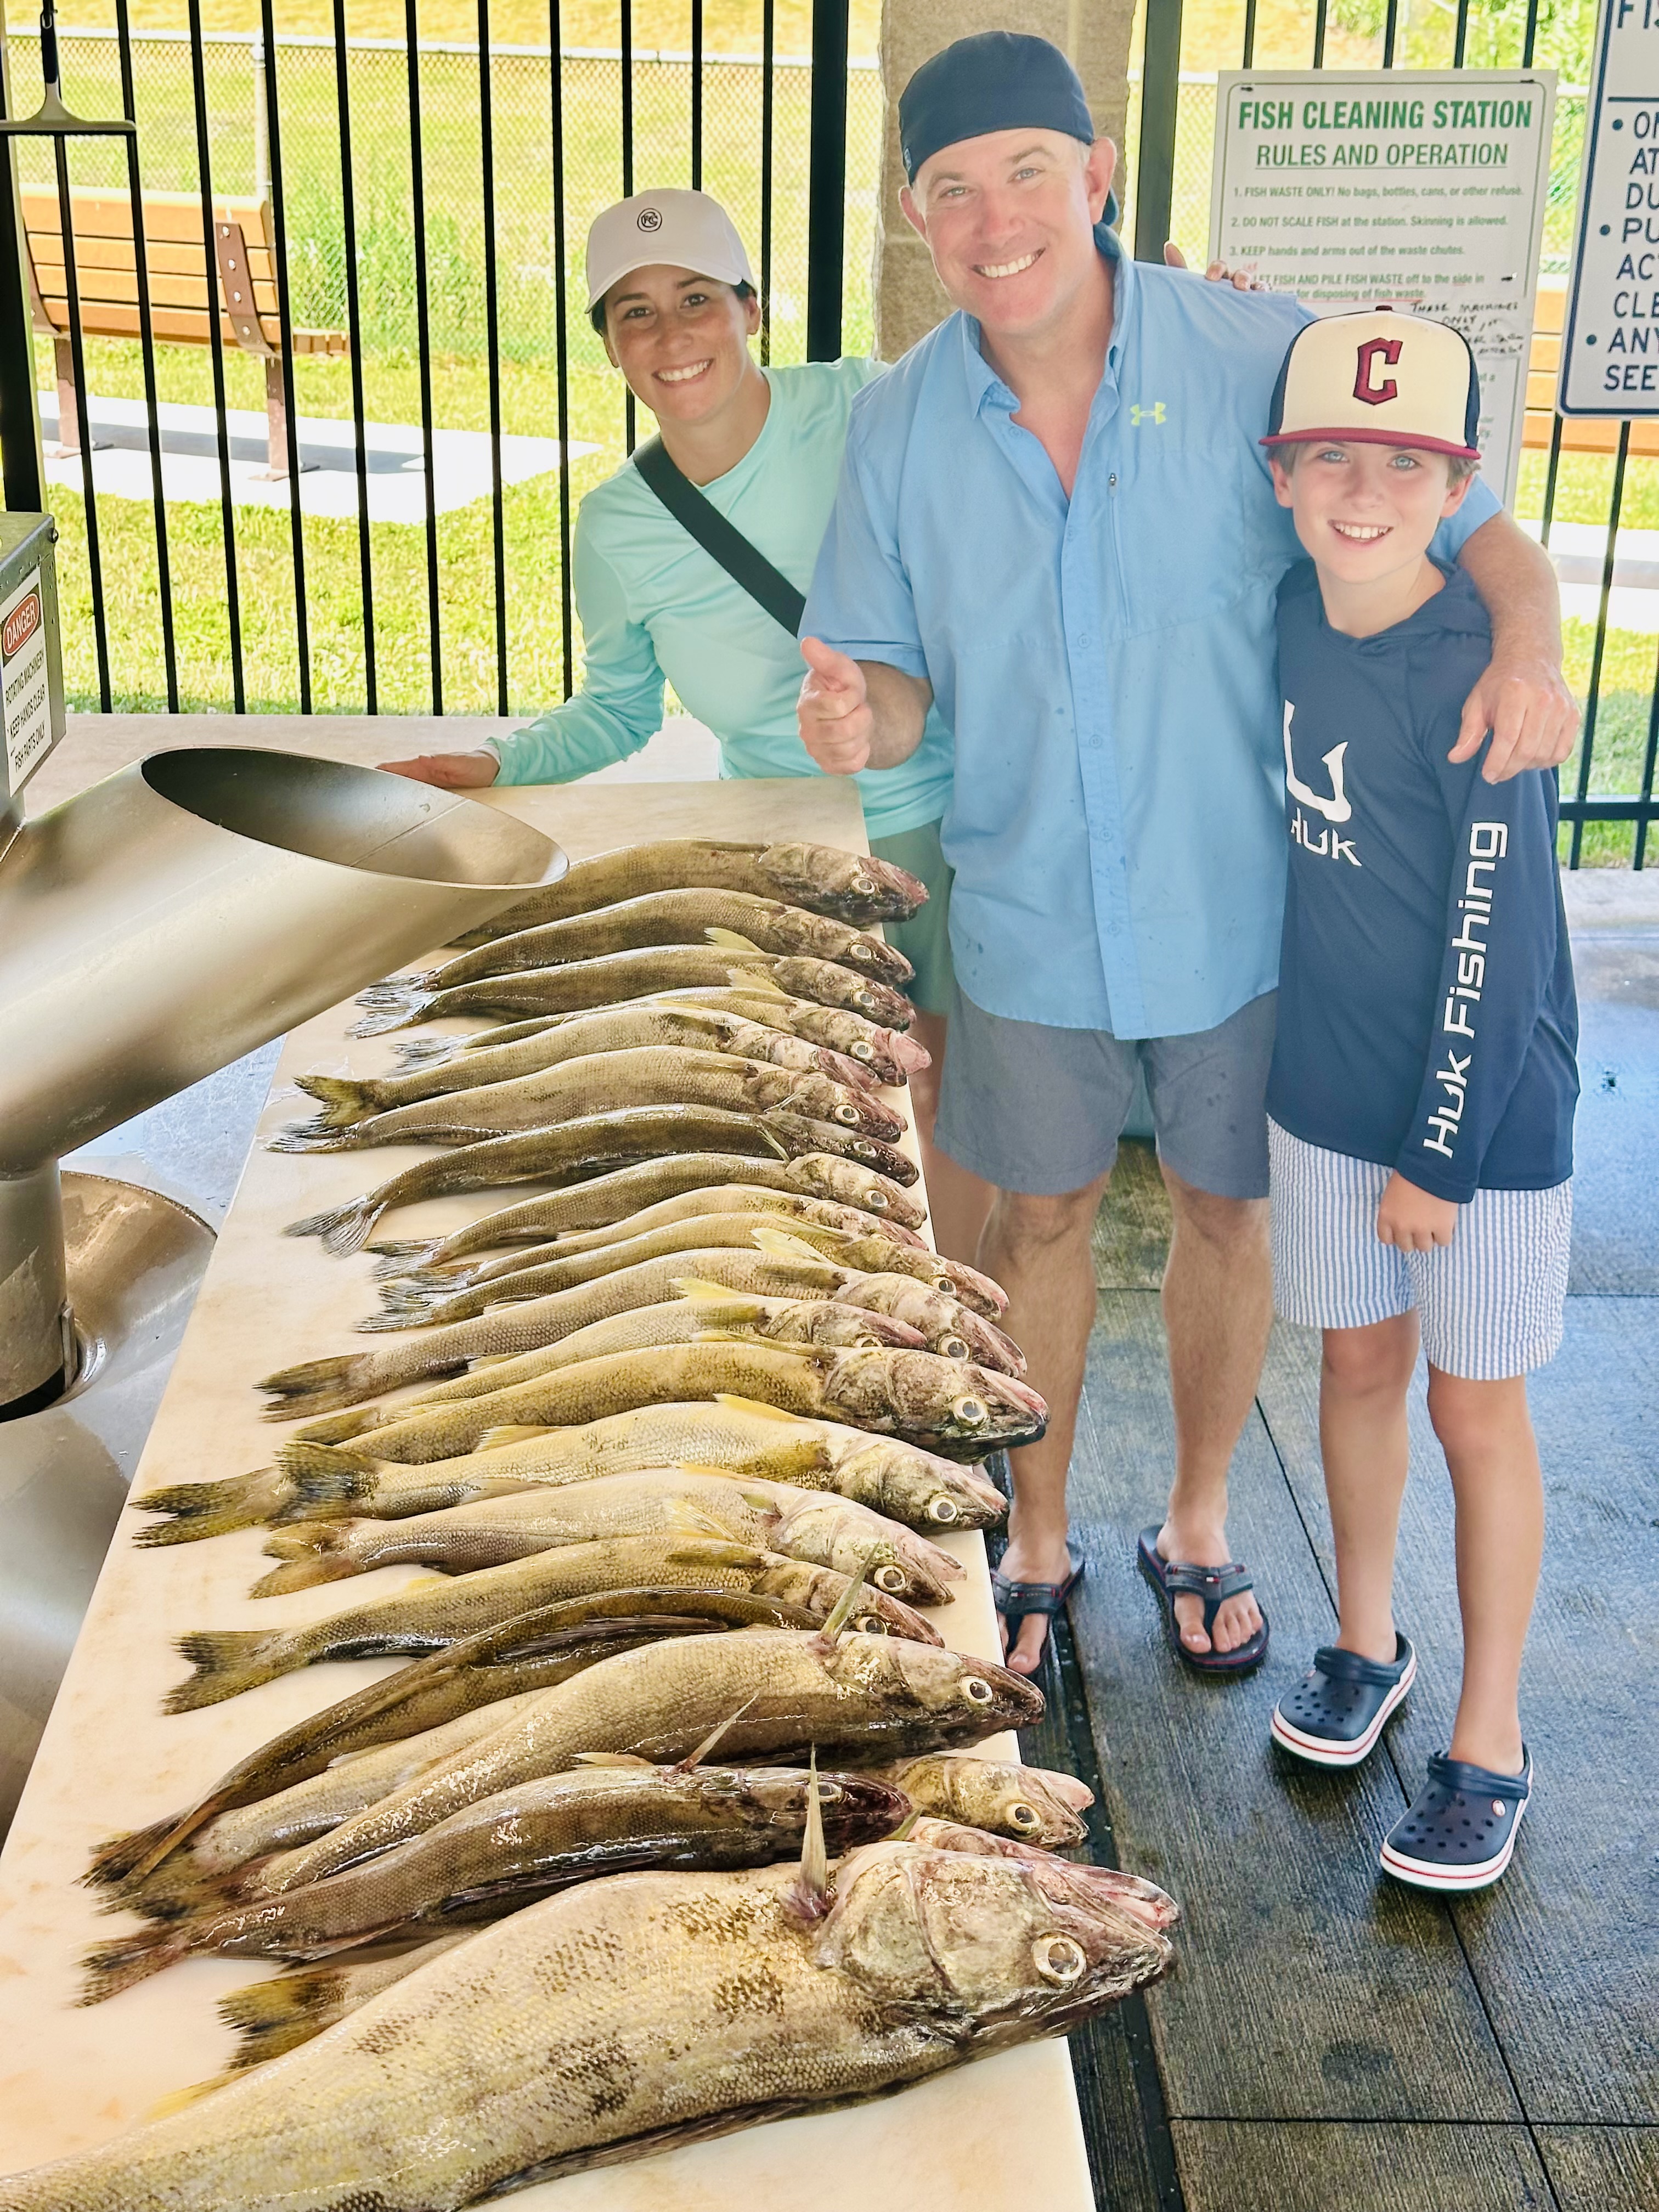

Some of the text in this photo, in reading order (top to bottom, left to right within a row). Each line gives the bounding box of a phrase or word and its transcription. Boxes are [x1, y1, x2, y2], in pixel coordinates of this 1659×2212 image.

[1617, 0, 1659, 29] FI
[1239, 100, 1532, 129] FISH CLEANING STATION
[1257, 143, 1508, 166] RULES AND OPERATION
[1234, 185, 1523, 199] 1. FISH WASTE ONLY! No bags, bottles, cans, or other refuse.
[1231, 215, 1507, 228] 2. DO NOT SCALE FISH at the station. Skinning is allowed.
[1229, 245, 1465, 255] 3. KEEP hands and arms out of the waste chutes.
[1274, 274, 1295, 284] FISH
[1299, 274, 1318, 284] AND
[1321, 274, 1342, 284] PILE
[1345, 274, 1368, 284] FISH
[1370, 274, 1402, 284] WASTE
[1406, 274, 1419, 284] off
[1422, 274, 1431, 284] to
[1435, 273, 1450, 283] the
[1452, 273, 1472, 283] side
[1475, 273, 1485, 283] in
[1616, 253, 1659, 280] AC
[1297, 289, 1310, 298] for
[1313, 289, 1359, 301] disposing
[1362, 289, 1372, 298] of
[1374, 289, 1392, 297] fish
[1395, 289, 1425, 297] waste.
[1352, 337, 1403, 406] C
[1603, 364, 1658, 391] SEE
[7, 600, 36, 650] DANGER
[5, 648, 44, 708] ROTATING MACHINERY
[9, 684, 46, 741] KEEP HANDS CLEAR
[15, 719, 45, 773] FISH PARTS ONLY
[1443, 821, 1508, 1039] Fishing
